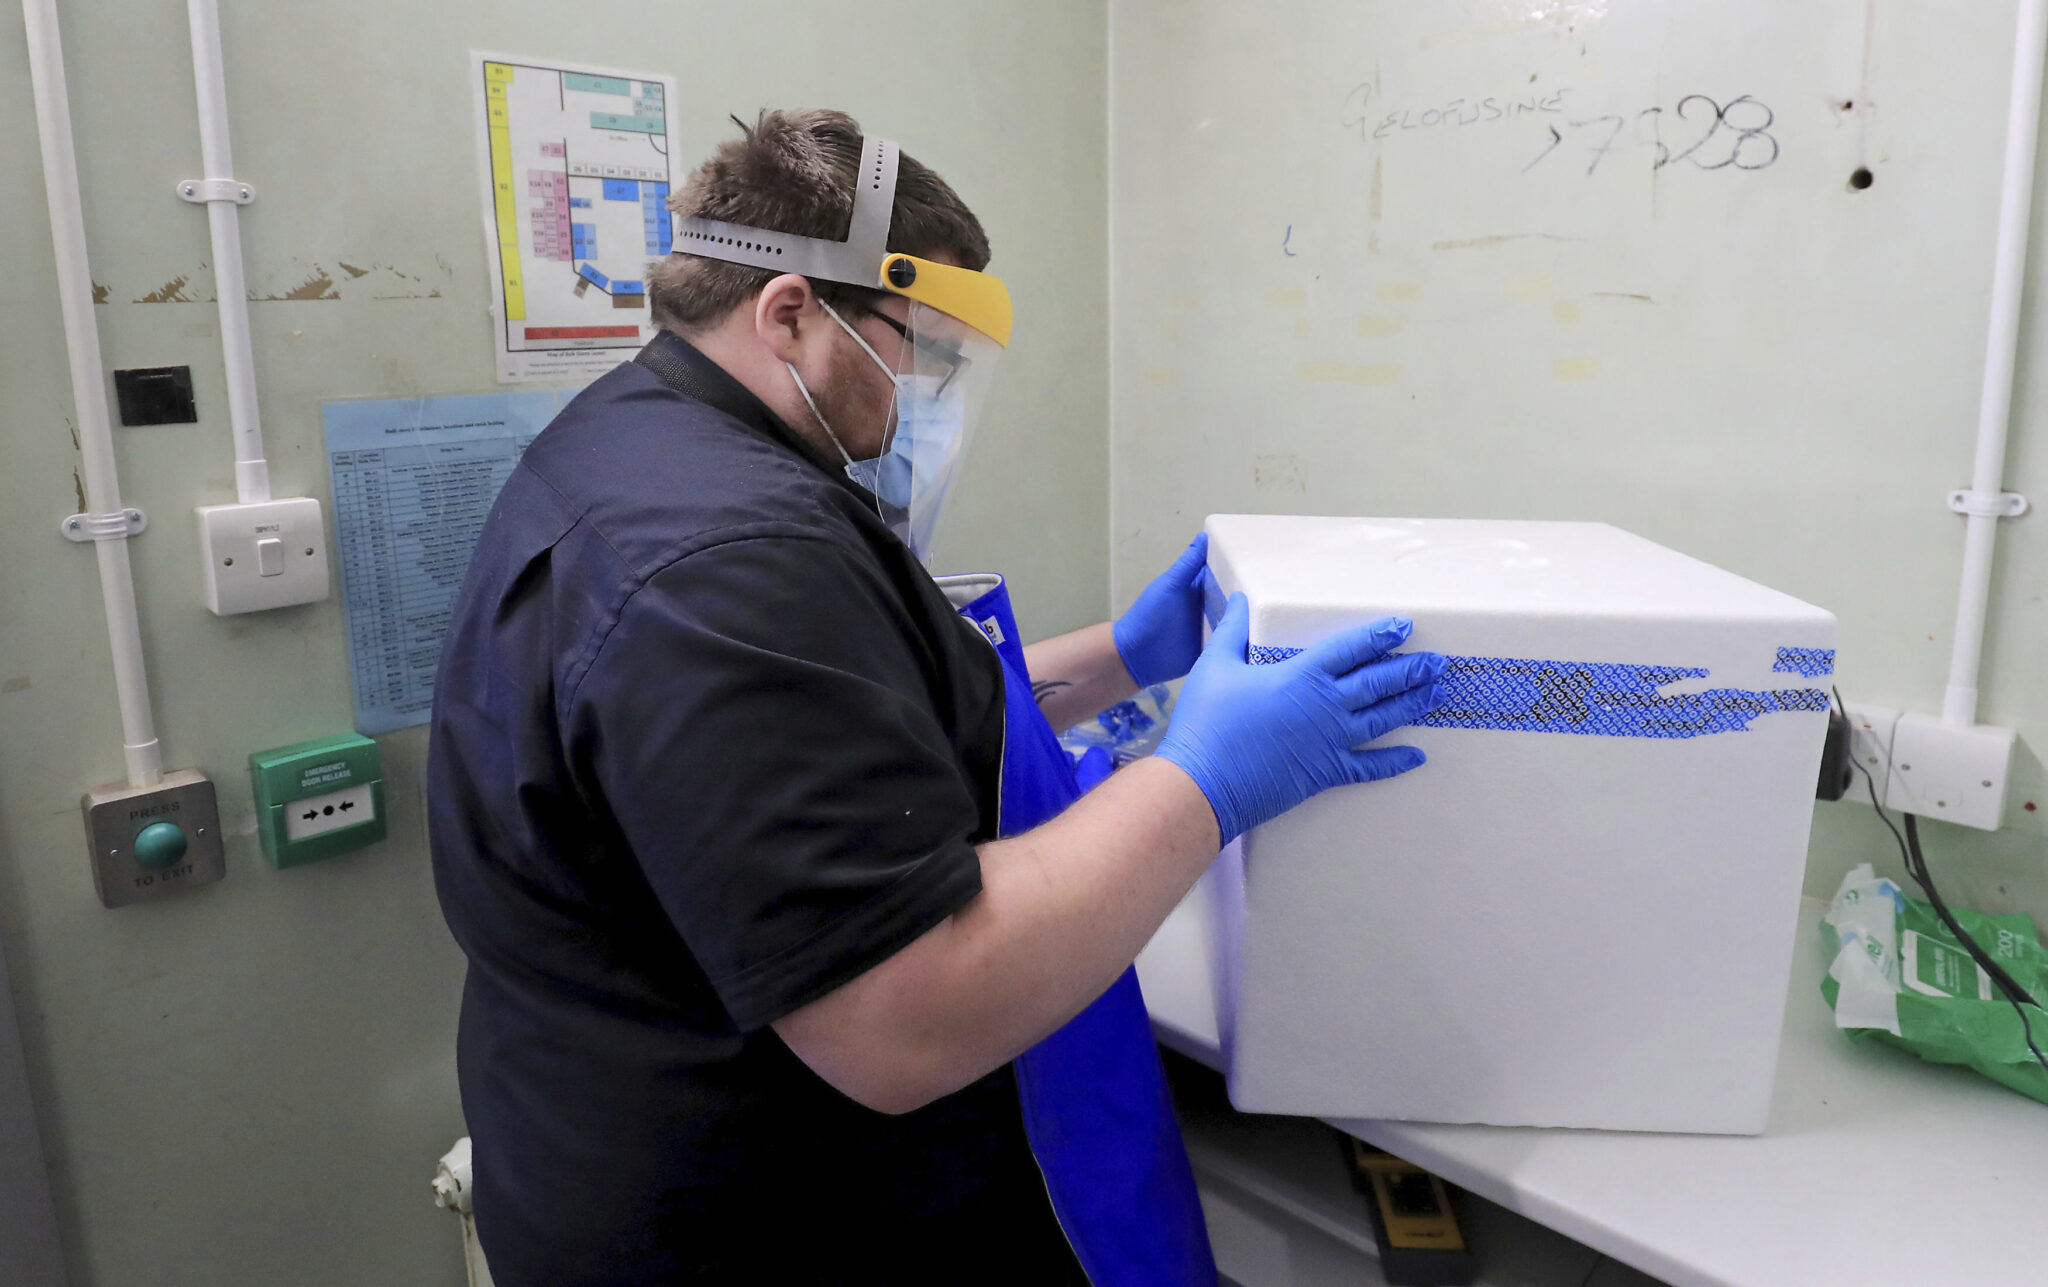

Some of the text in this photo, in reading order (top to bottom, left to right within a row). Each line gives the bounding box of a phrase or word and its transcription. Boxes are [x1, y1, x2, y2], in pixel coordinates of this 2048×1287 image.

[1469, 660, 1522, 717] VOID OPEN VOID
[1572, 672, 1590, 692] OPEN
[1790, 650, 1811, 672] VOID
[1442, 682, 1476, 721] VOID OPEN
[1448, 678, 1486, 716] OPEN VOID
[1452, 705, 1472, 726] VOID
[1456, 670, 1508, 728] VOID OPEN VOID
[1462, 667, 1512, 722] OPEN VOID OPEN
[1492, 672, 1512, 694] VOID
[1508, 692, 1526, 712] OPEN
[1525, 708, 1545, 730] VOID
[1498, 668, 1549, 724] OPEN VOID OPEN
[1506, 661, 1559, 719] VOID OPEN VOID
[1529, 674, 1550, 696] VOID
[1545, 694, 1563, 714] OPEN
[1562, 710, 1582, 732] VOID
[1535, 670, 1586, 726] OPEN VOID OPEN
[1543, 663, 1596, 721] VOID OPEN VOID
[1566, 676, 1586, 698] VOID
[1582, 696, 1600, 716] OPEN
[1598, 712, 1618, 734] VOID
[1580, 665, 1632, 723] VOID OPEN VOID
[1603, 678, 1623, 699] VOID
[1618, 698, 1636, 718] OPEN
[1635, 714, 1655, 736] VOID
[1609, 674, 1659, 730] OPEN VOID OPEN
[1616, 667, 1669, 725] VOID OPEN VOID
[1640, 680, 1660, 701] VOID
[1655, 700, 1673, 719] OPEN
[1672, 716, 1692, 738] VOID
[1685, 705, 1706, 727] VOID
[1692, 702, 1710, 721] OPEN
[1700, 694, 1720, 716] VOID
[1706, 691, 1742, 728] OPEN VOID
[1743, 693, 1760, 712] OPEN
[1678, 712, 1696, 732] OPEN
[129, 801, 180, 821] PRESS
[134, 864, 194, 888] TO EXIT
